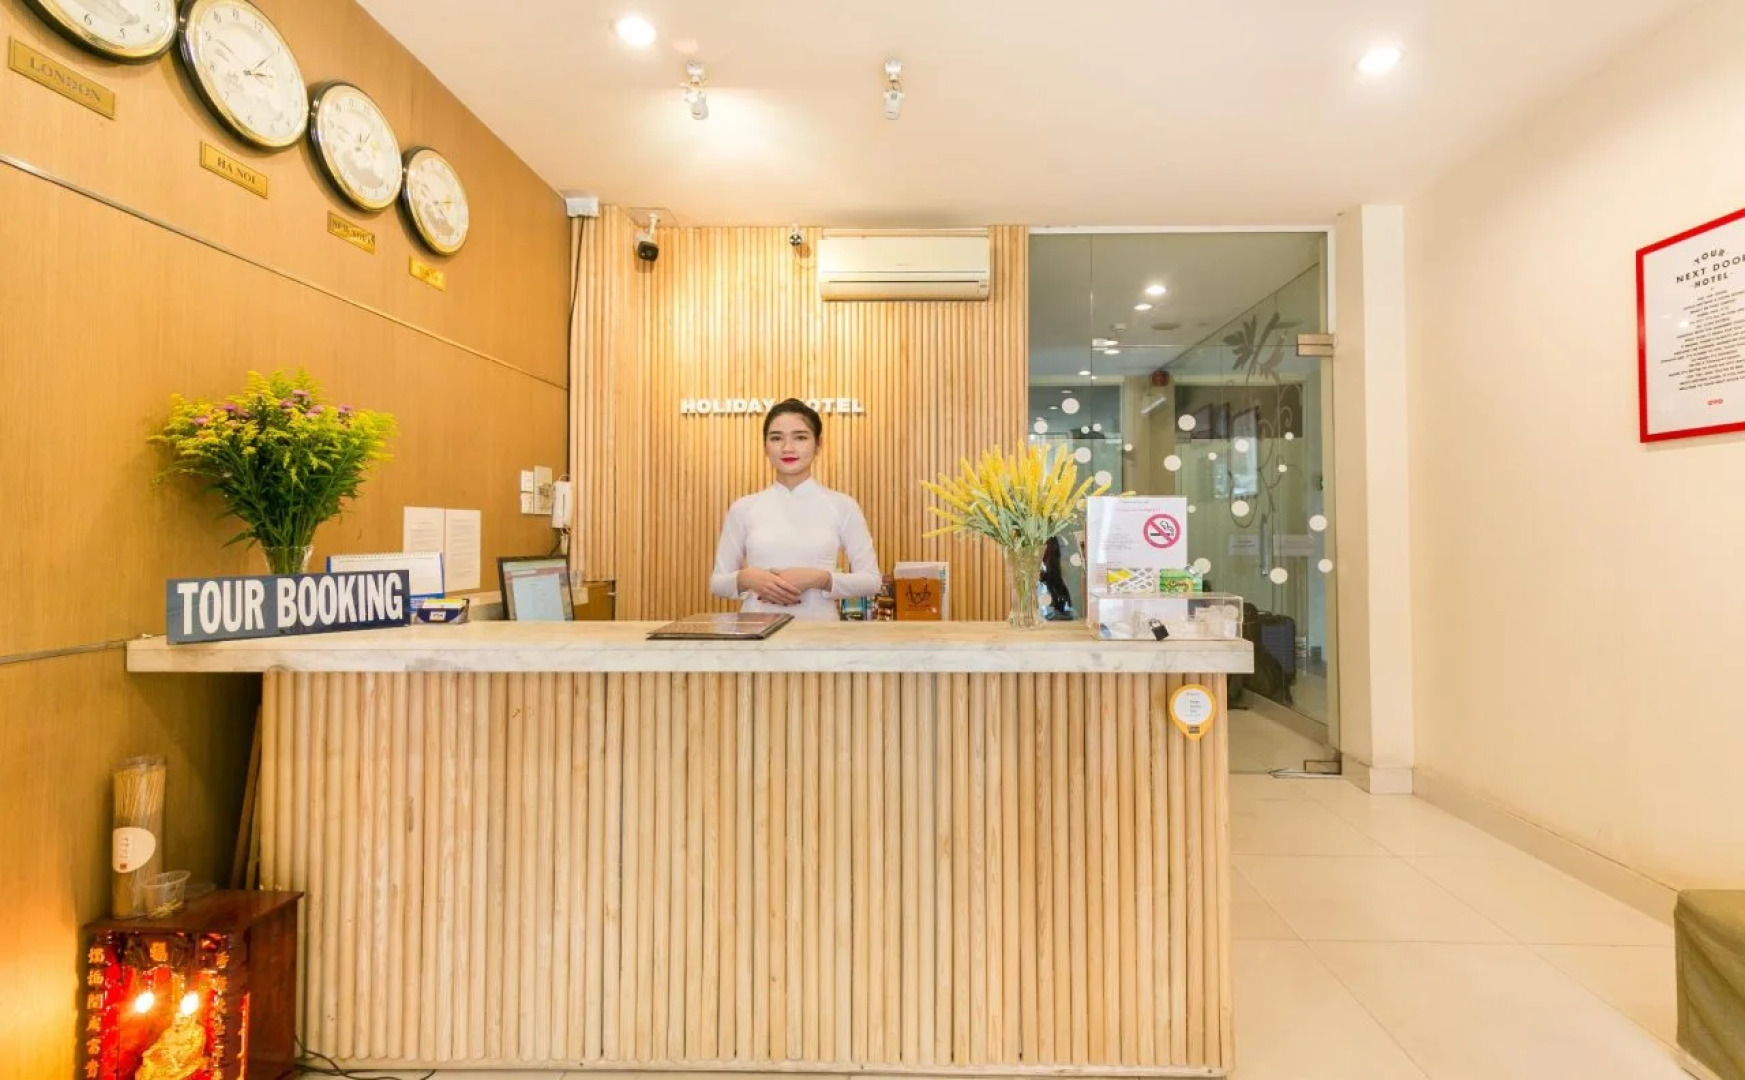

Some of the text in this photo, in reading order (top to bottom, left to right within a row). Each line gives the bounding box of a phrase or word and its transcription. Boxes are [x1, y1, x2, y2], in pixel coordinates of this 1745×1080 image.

[30, 56, 102, 102] LONDON
[217, 156, 256, 184] HA NOI
[1694, 248, 1726, 264] YOUR
[1676, 267, 1707, 284] NEXT
[1694, 272, 1729, 288] HOTEL
[681, 397, 866, 414] HOLIDAY OTEL
[177, 571, 405, 635] TOUR BOOKING
